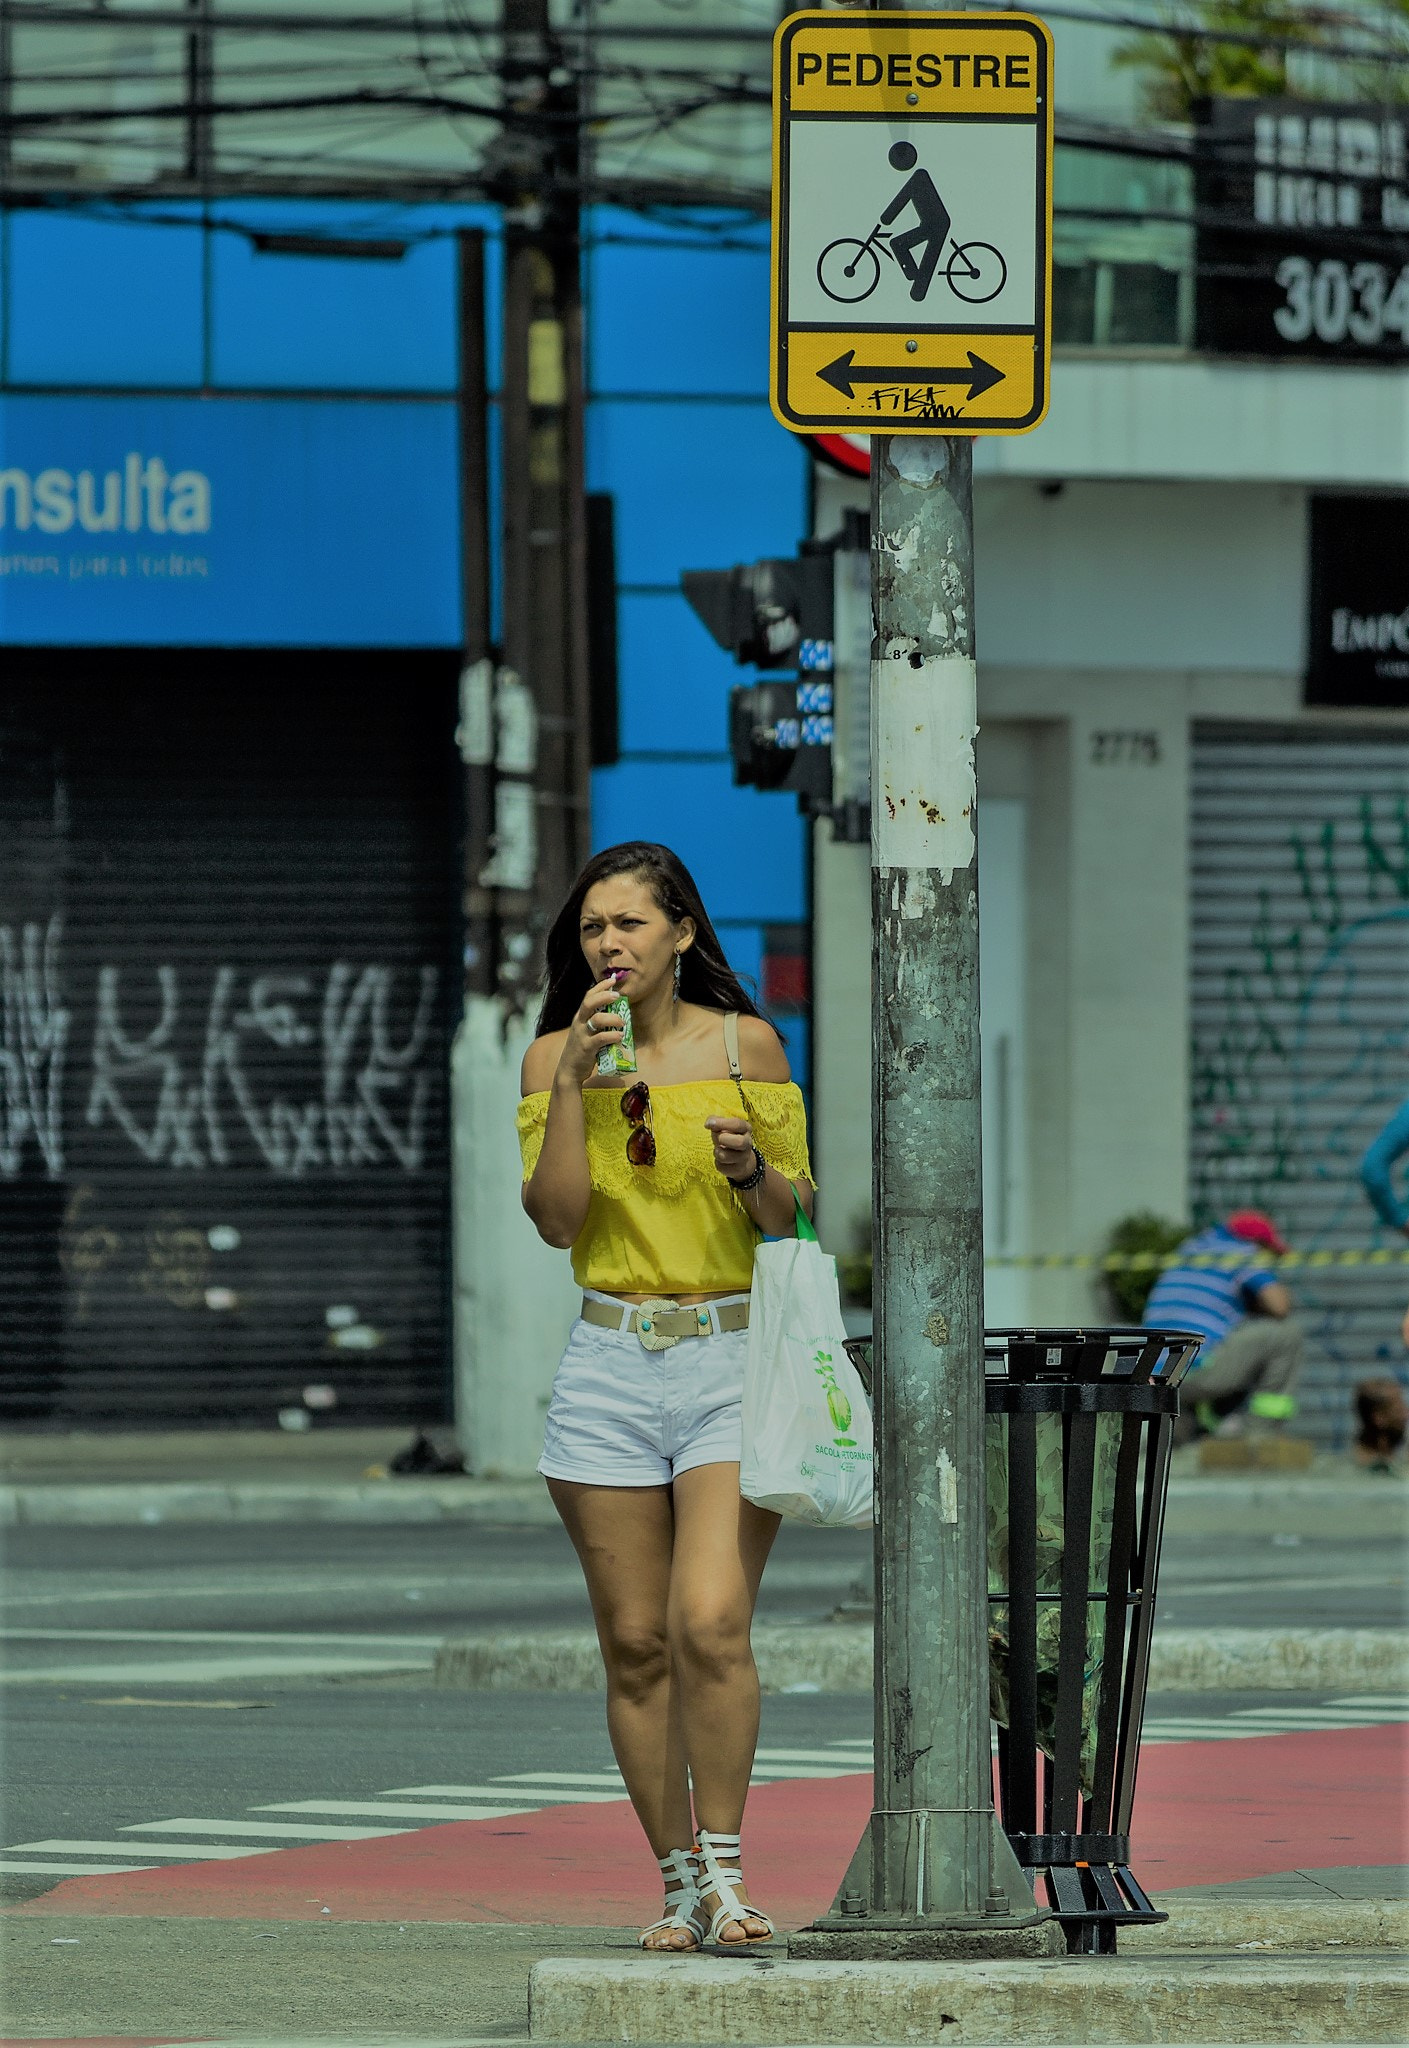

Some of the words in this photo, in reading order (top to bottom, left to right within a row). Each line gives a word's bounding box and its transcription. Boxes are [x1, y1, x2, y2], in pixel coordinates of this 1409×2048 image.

[796, 52, 1031, 89] PEDESTRE
[1273, 255, 1409, 347] 3034
[815, 1444, 841, 1459] SACOLA
